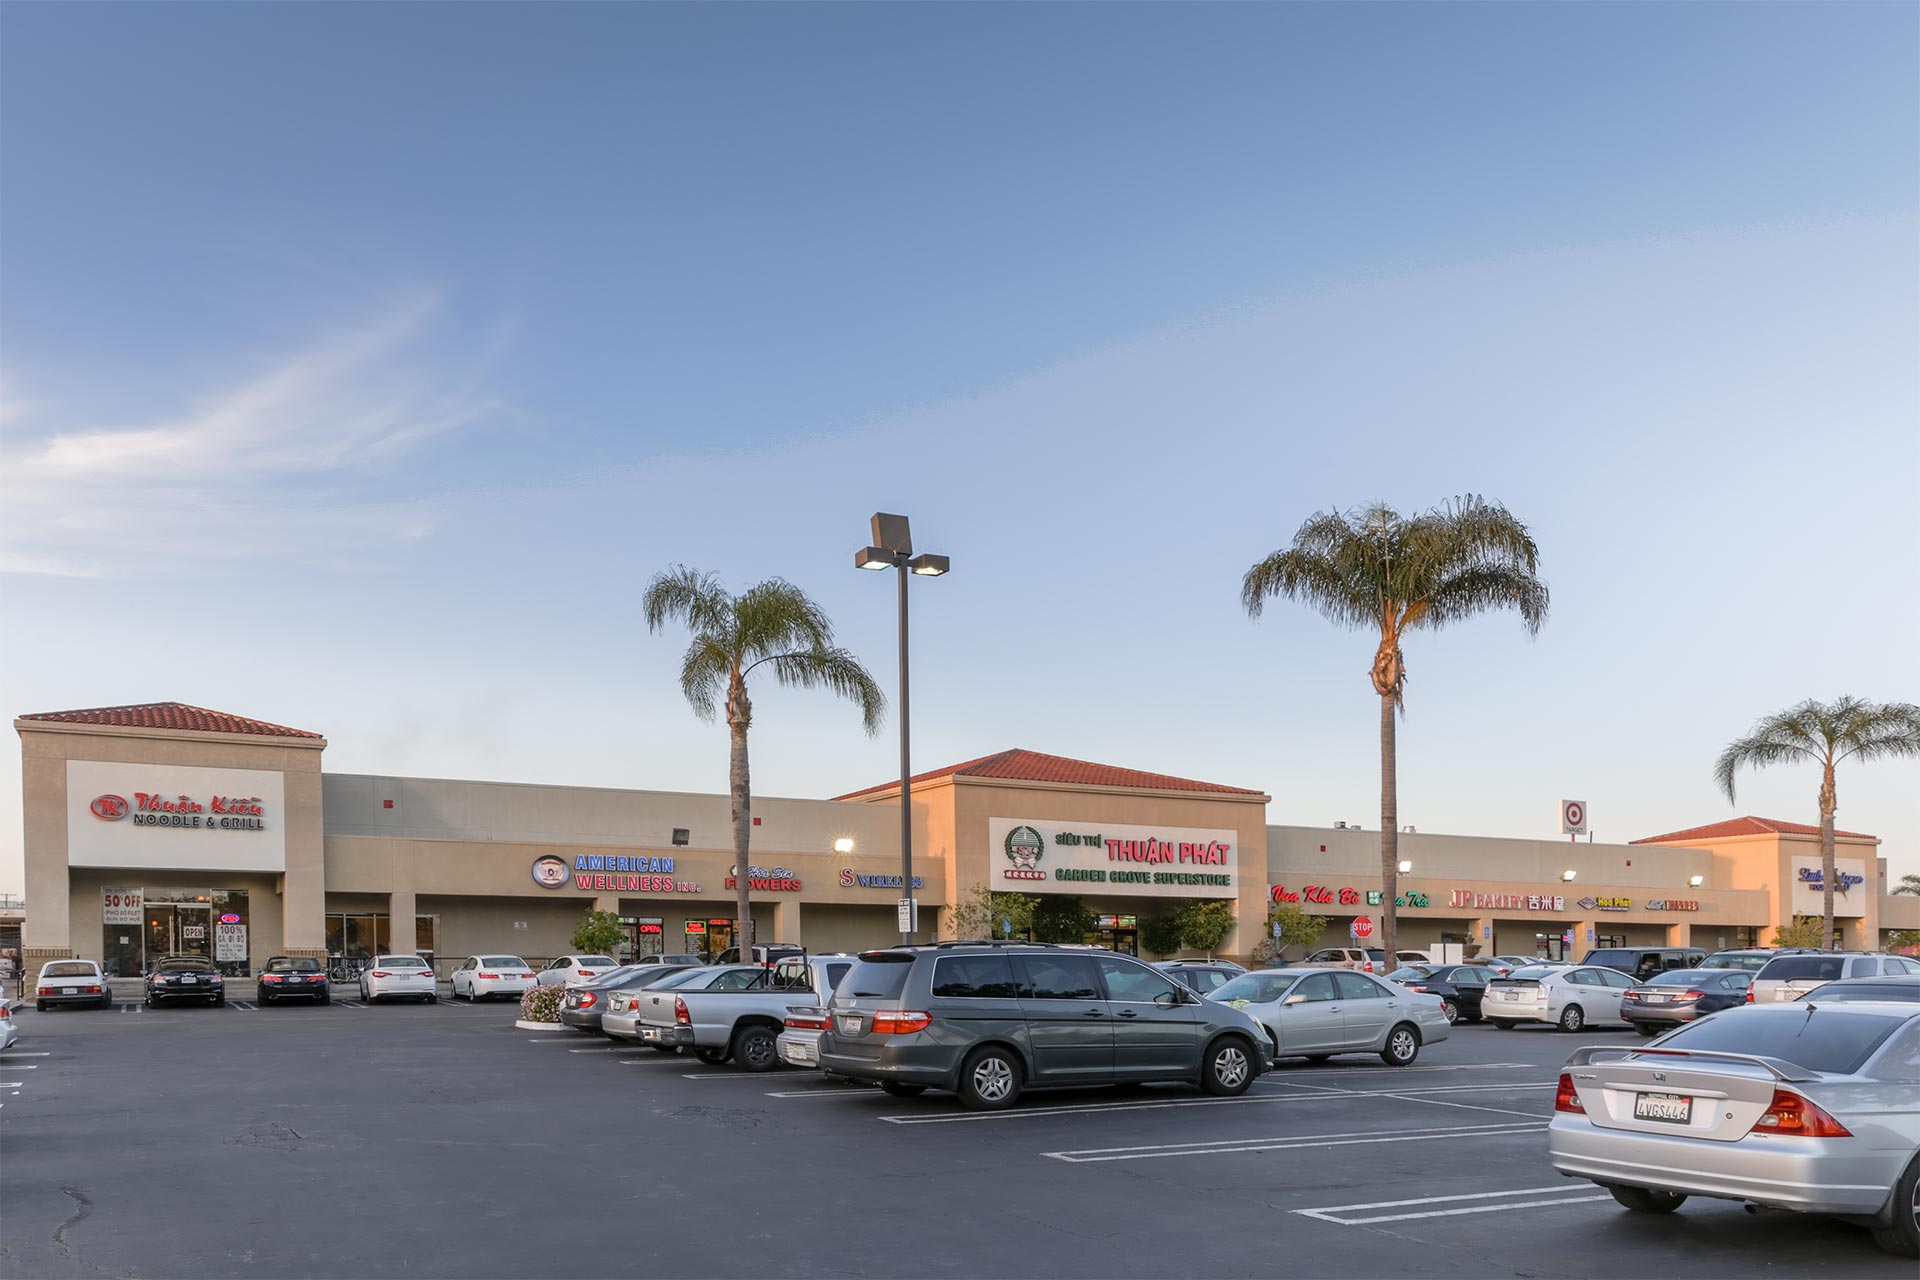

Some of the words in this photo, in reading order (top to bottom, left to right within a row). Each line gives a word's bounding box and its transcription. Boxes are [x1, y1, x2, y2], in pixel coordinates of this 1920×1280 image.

[134, 814, 200, 828] NOODLE
[206, 817, 215, 828] &
[220, 817, 264, 830] GRILL
[1105, 836, 1174, 865] THUẬN
[1179, 840, 1230, 865] PHÁT
[575, 854, 674, 873] AMERICAN
[771, 866, 793, 878] Sen
[575, 874, 673, 891] WELLNESS
[676, 882, 701, 892] INC.
[840, 867, 855, 887] S
[857, 873, 924, 889] WIRELSS
[1055, 868, 1106, 883] GARDEN
[1110, 870, 1151, 884] GROVE
[1154, 872, 1231, 886] SUPERSTORE
[124, 894, 141, 907] OFF
[1271, 884, 1299, 902] Vua
[1339, 887, 1361, 905] Bò
[1406, 891, 1429, 908] Trà
[1449, 889, 1472, 908] JP
[1473, 894, 1524, 909] BAKERY
[1528, 895, 1565, 911] 吉米屋
[185, 928, 203, 937] OPEN
[220, 926, 242, 934] 100%
[640, 925, 660, 933] OPEN
[1354, 923, 1372, 931] STOP
[1639, 1102, 1686, 1119] 4VGS446
